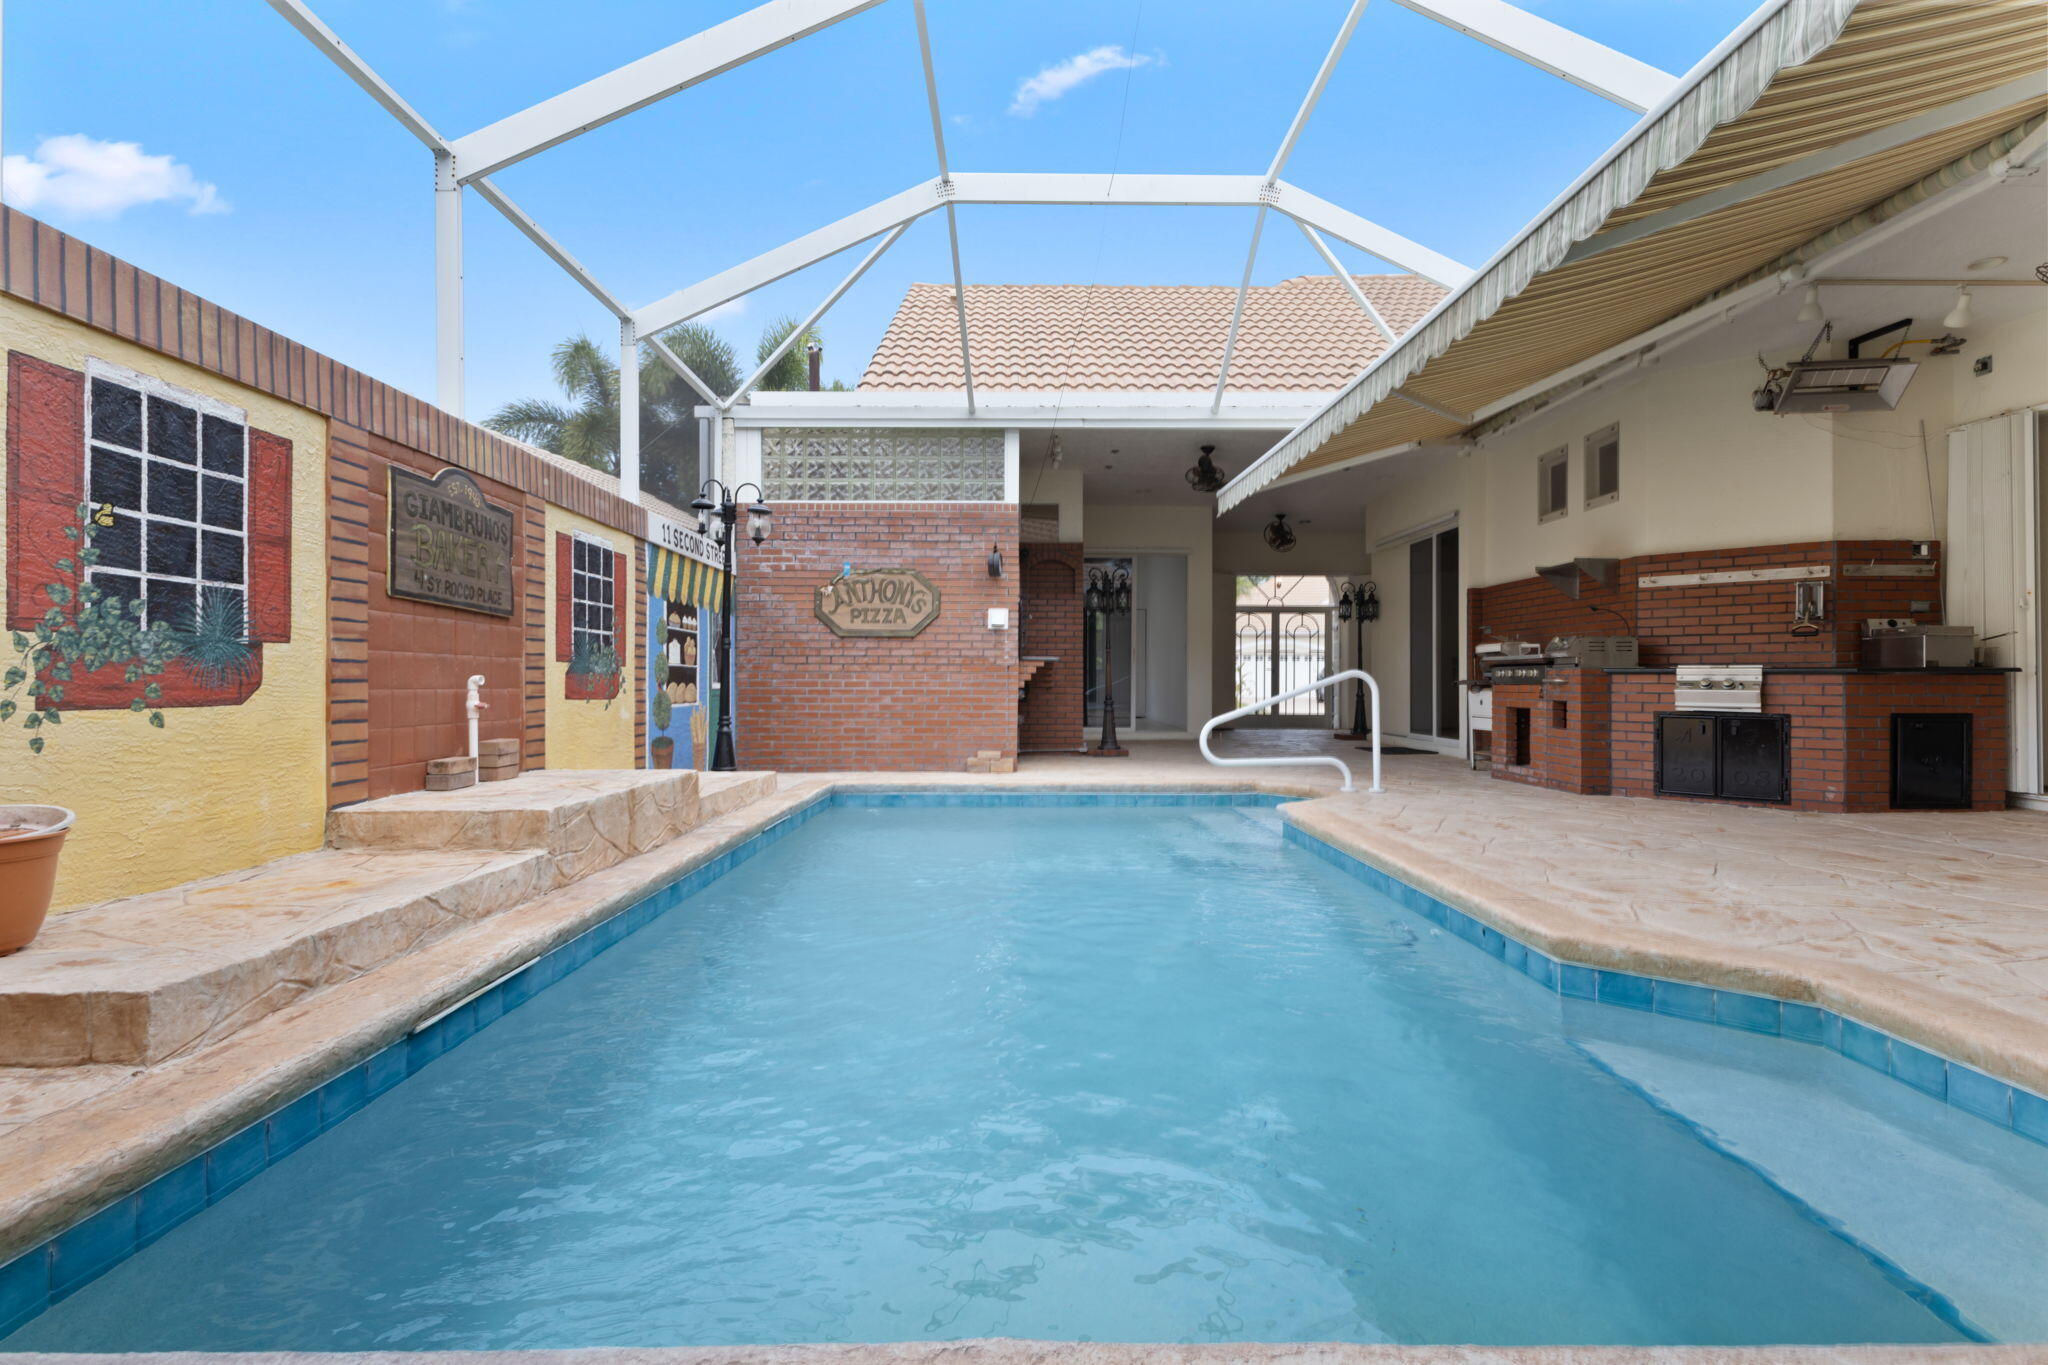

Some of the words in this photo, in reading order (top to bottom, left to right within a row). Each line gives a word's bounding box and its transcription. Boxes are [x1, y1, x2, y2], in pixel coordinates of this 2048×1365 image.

[410, 523, 506, 585] BAKERY
[662, 523, 671, 545] 11
[673, 528, 704, 558] SECOND
[444, 580, 475, 601] ROCCO
[478, 587, 503, 606] PLACE
[850, 607, 907, 624] PIZZA
